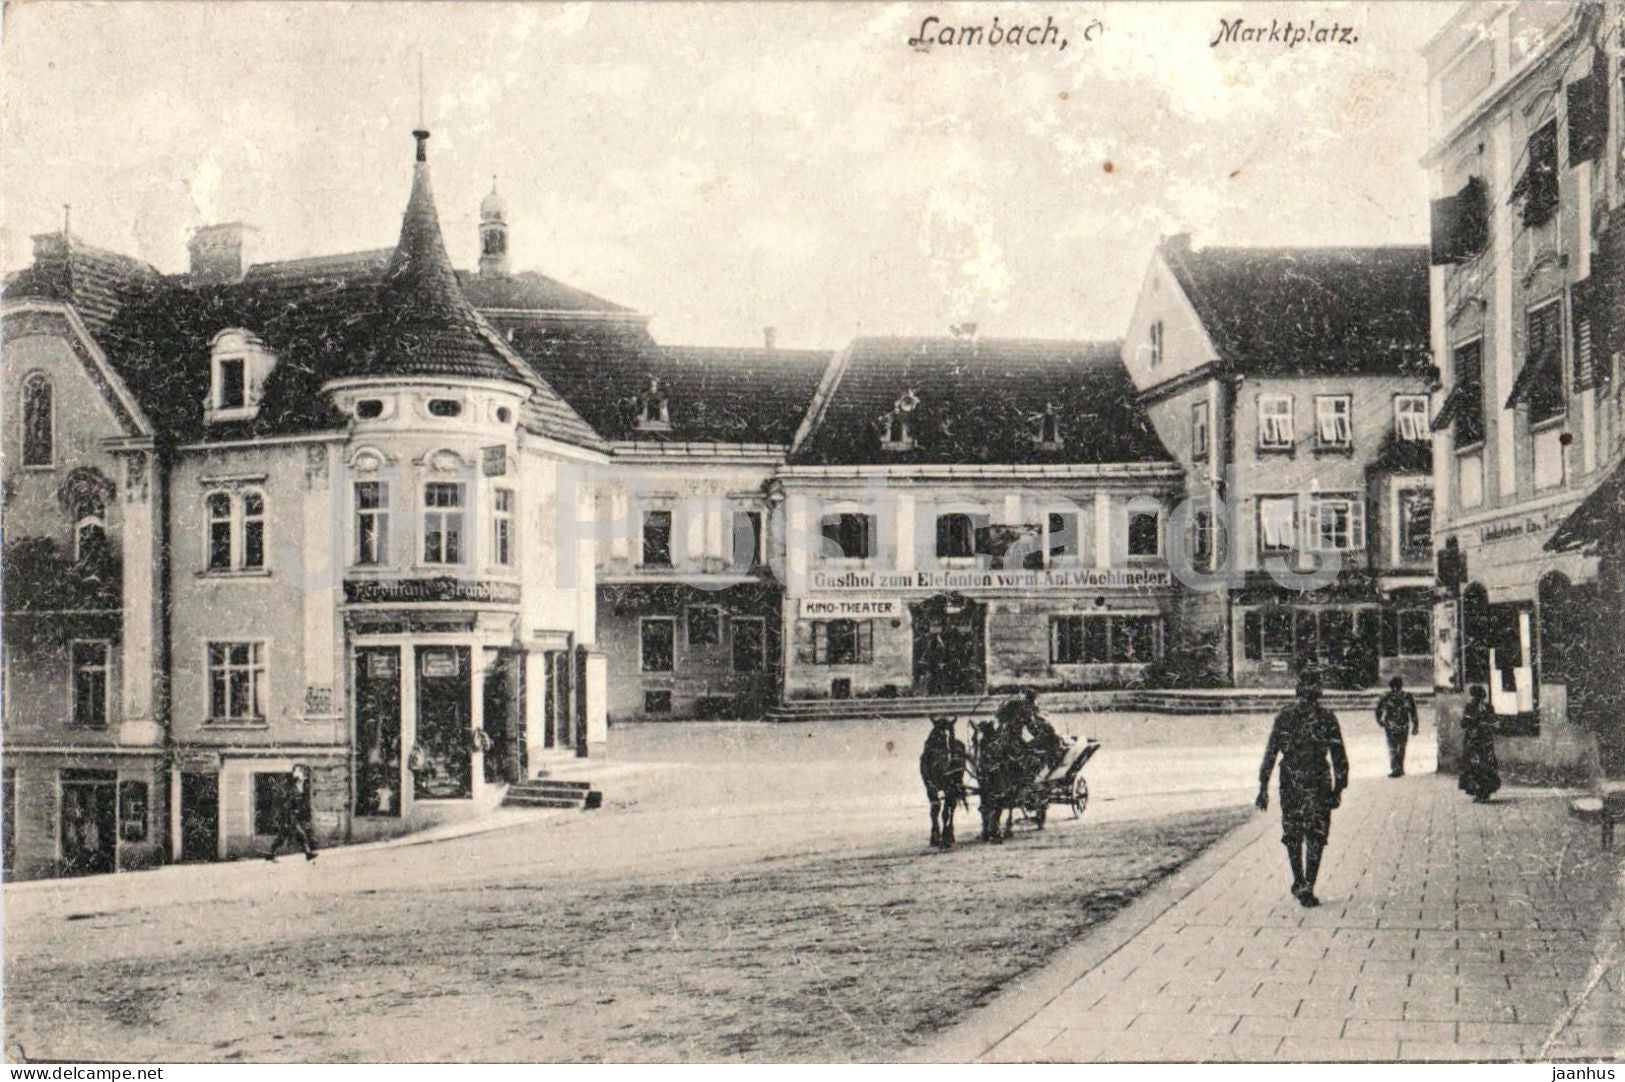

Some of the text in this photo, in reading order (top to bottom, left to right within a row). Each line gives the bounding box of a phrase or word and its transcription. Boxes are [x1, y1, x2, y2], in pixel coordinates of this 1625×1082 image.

[814, 572, 874, 587] Gasthof
[880, 575, 912, 587] zum
[918, 571, 992, 587] Elefanten
[806, 602, 892, 613] KINO-THEATER
